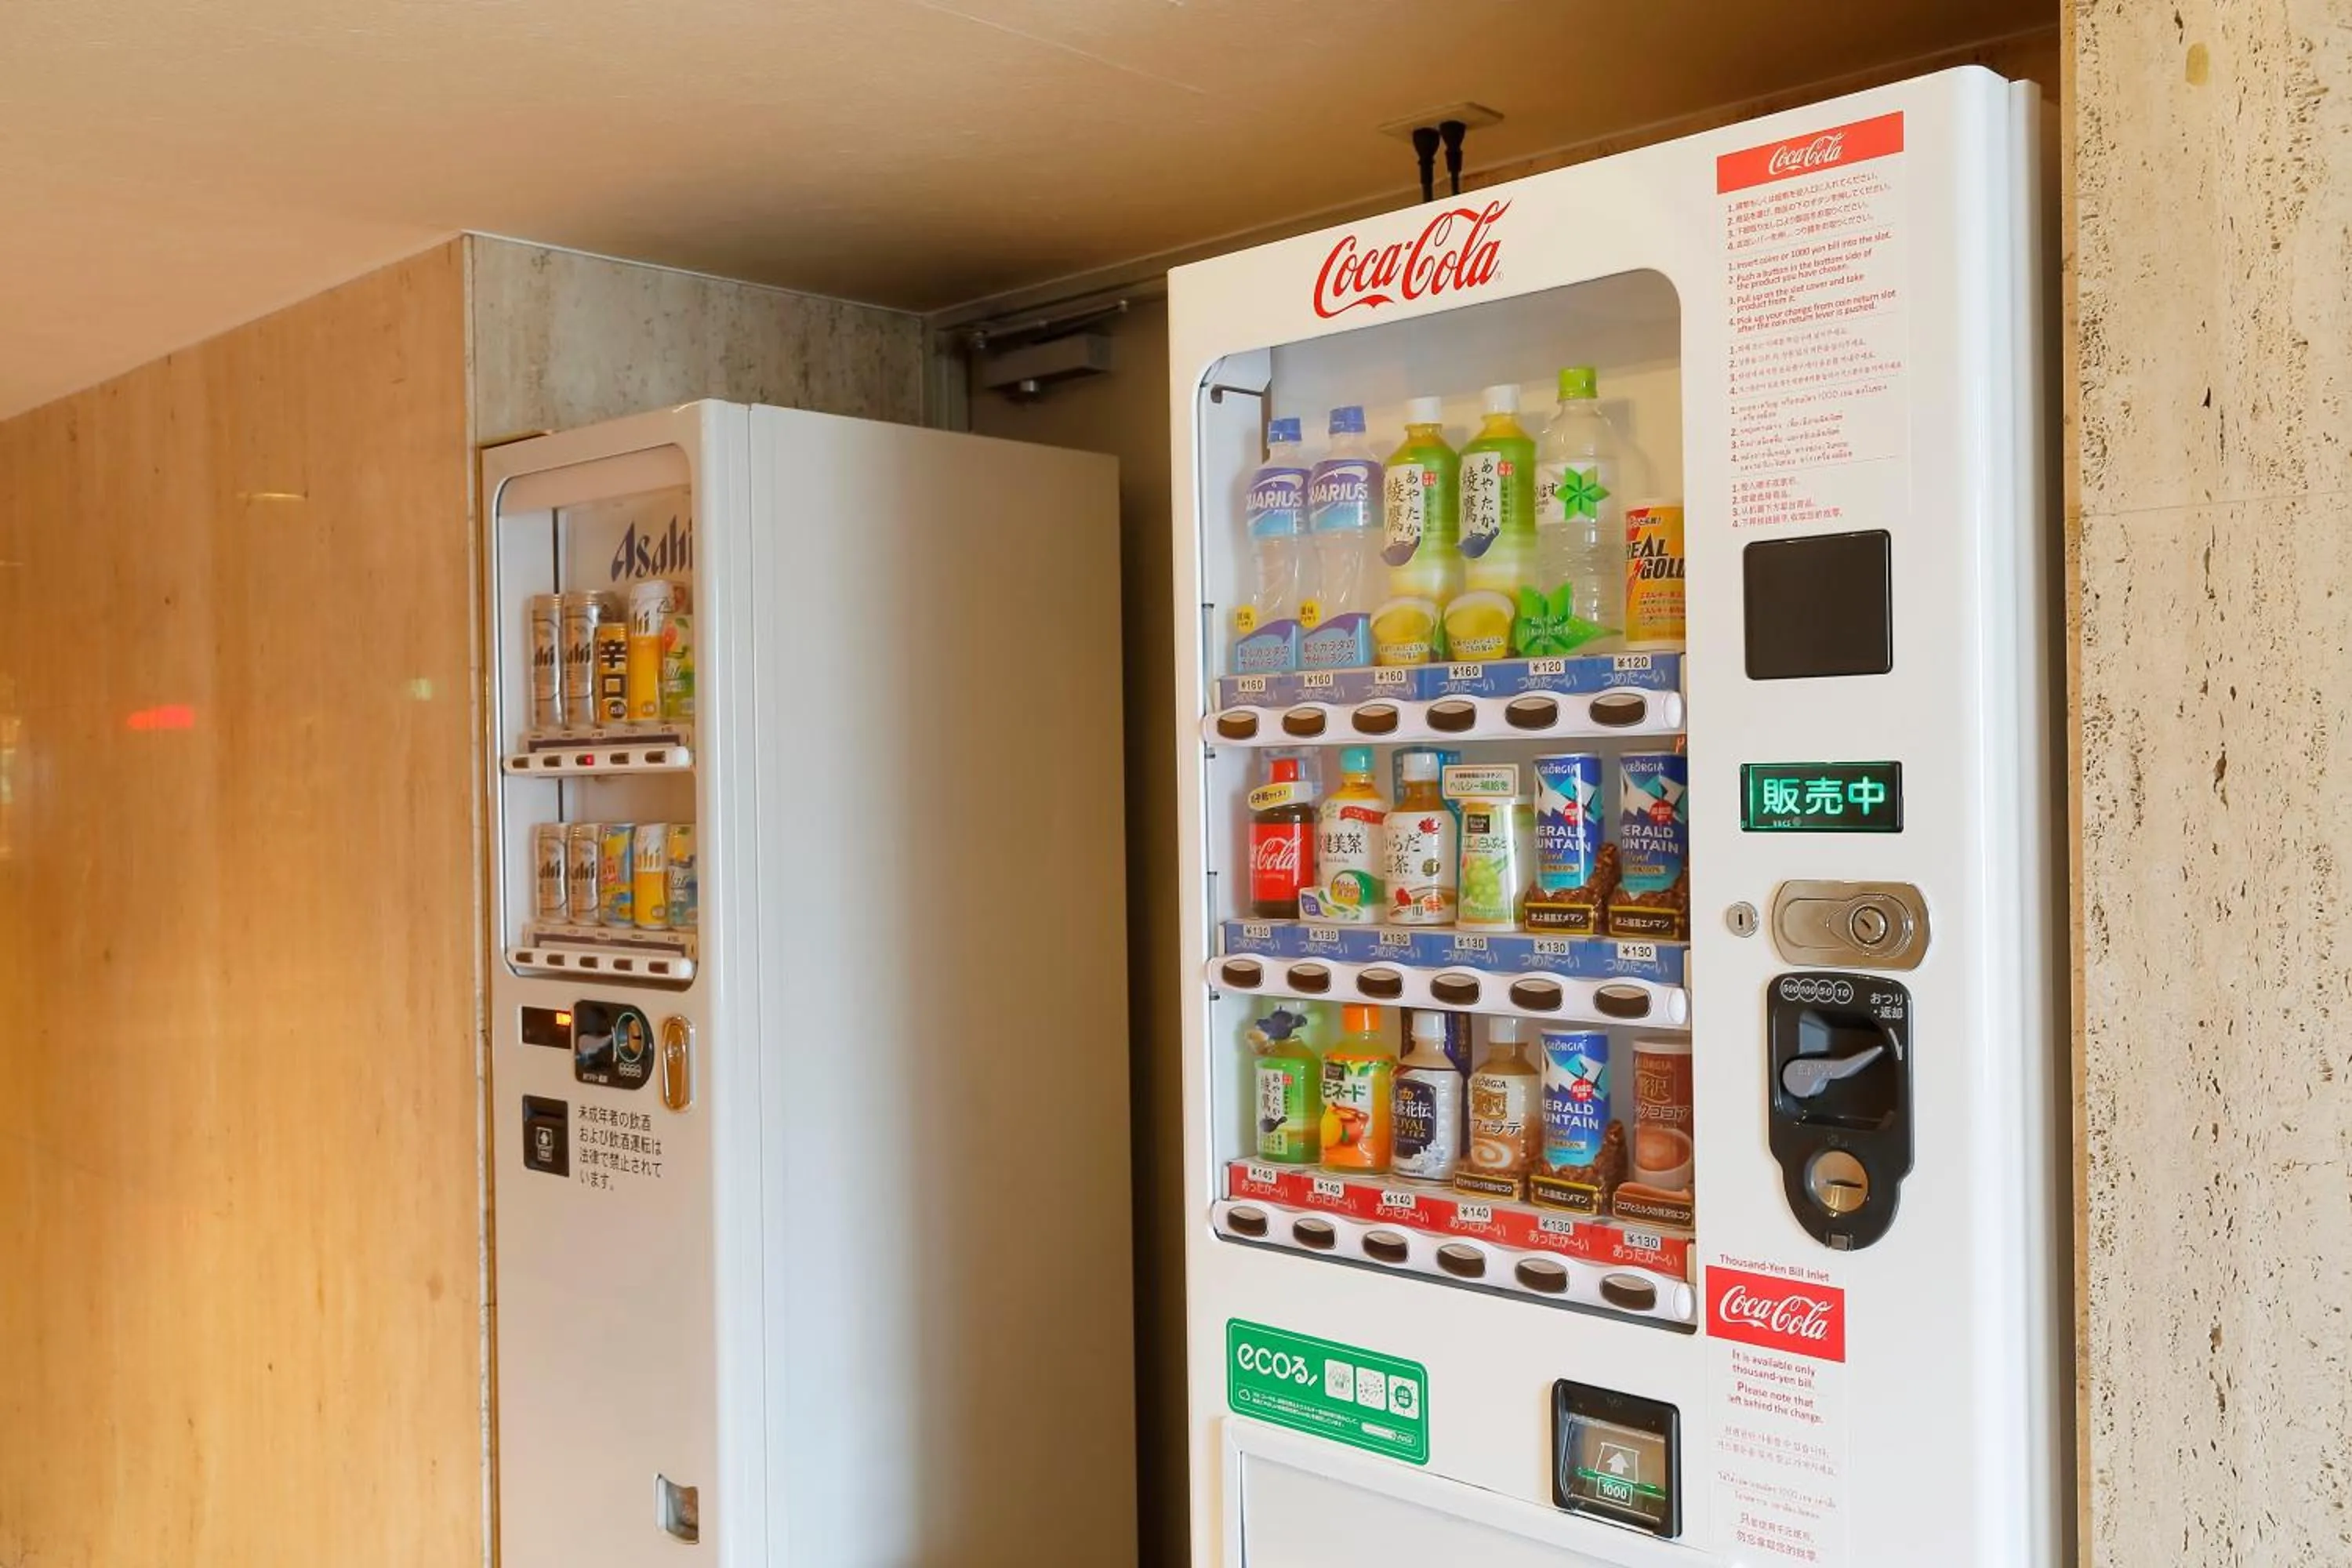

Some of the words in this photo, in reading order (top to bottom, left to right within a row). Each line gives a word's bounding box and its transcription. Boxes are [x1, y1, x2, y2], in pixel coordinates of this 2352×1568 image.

[1769, 132, 1846, 175] Coca-Cola
[1860, 235, 1873, 244] the
[1313, 198, 1512, 318] Coca-Cola
[1799, 260, 1812, 270] the
[600, 639, 626, 698] 辛口
[1532, 662, 1562, 673] ¥120
[1617, 657, 1648, 668] ¥120
[1762, 776, 1885, 815] 販売中
[1536, 825, 1587, 838] ERALD
[1457, 937, 1485, 948] ¥130
[1537, 942, 1566, 953] ¥130
[1622, 946, 1652, 957] ¥130
[1870, 993, 1904, 1006] おつり
[1543, 1100, 1594, 1116] ERALD
[578, 1106, 651, 1131] 未成年者の飲酒
[579, 1128, 662, 1155] および飲酒運転は
[579, 1148, 662, 1178] 法律で禁止されて
[1385, 1192, 1410, 1206] ¥140
[1461, 1206, 1489, 1218] ¥140
[1542, 1218, 1570, 1233] ¥130
[1627, 1233, 1658, 1249] ¥130
[1788, 1266, 1804, 1278] Bill
[1719, 1285, 1835, 1341] Coca-Cola
[1732, 1348, 1740, 1359] It
[1751, 1354, 1792, 1370] available
[1793, 1396, 1813, 1409] that
[1773, 1405, 1788, 1417] the
[1602, 1482, 1628, 1500] 1000
